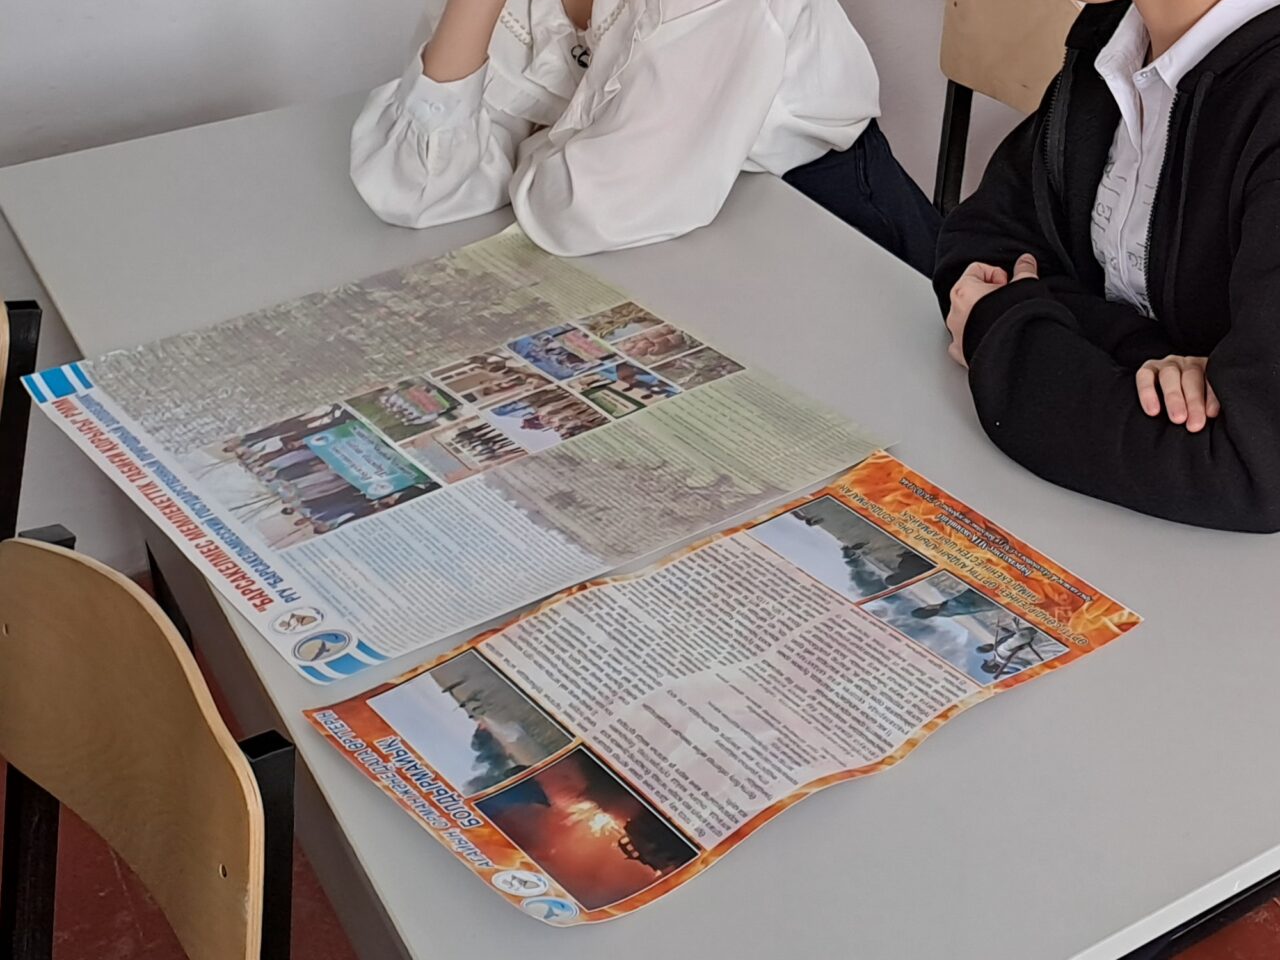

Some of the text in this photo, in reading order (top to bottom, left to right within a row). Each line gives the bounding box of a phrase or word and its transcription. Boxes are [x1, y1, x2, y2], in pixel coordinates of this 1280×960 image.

[134, 480, 209, 542] МЕМЛЕКЕТТІК
[193, 538, 280, 612] "БАРСАКЕЛМЕС
[275, 586, 302, 603] РГУ
